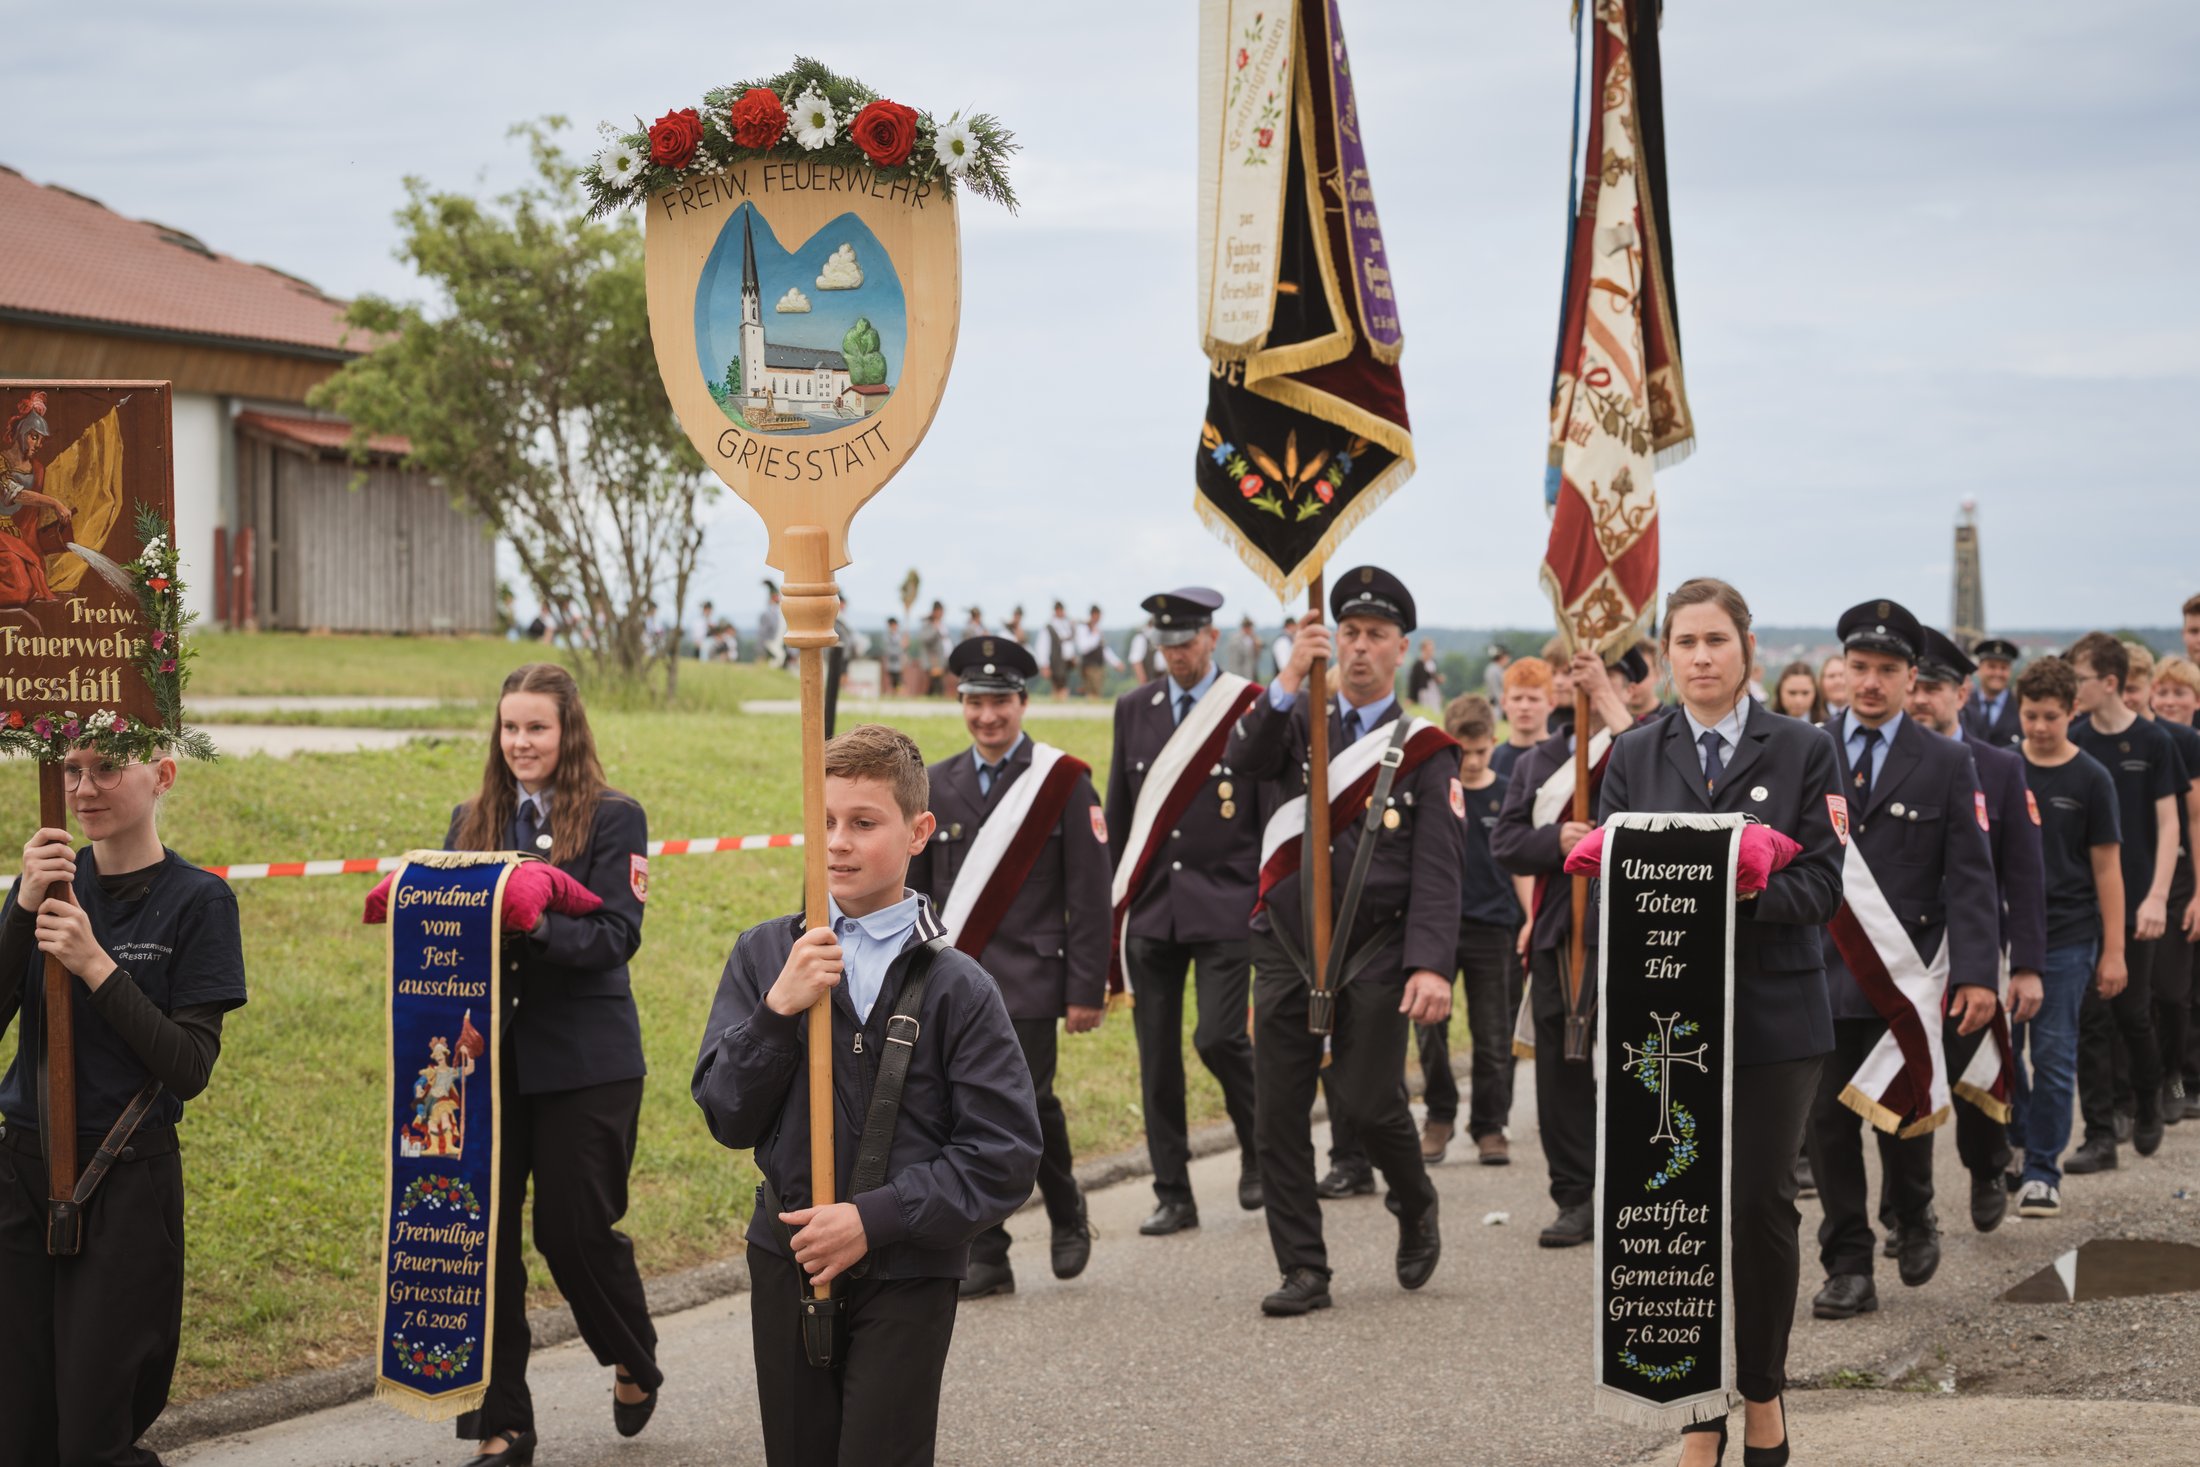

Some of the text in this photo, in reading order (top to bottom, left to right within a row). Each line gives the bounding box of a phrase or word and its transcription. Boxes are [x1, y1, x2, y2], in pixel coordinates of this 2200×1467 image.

[661, 169, 751, 221] FREIW.
[717, 421, 891, 481] GRIESSTÄTT
[65, 597, 139, 624] Freiw.
[1621, 858, 1714, 881] Unseren
[398, 884, 489, 909] Gewidmet
[1635, 890, 1697, 914] Toten
[421, 919, 462, 937] vom
[1645, 929, 1686, 946] zur
[420, 946, 464, 970] Fest-
[1645, 955, 1687, 979] Ehr
[398, 975, 487, 997] ausschuss
[1616, 1199, 1710, 1230] gestiftet
[391, 1221, 485, 1252] Freiwillige
[1619, 1232, 1706, 1256] von der
[390, 1251, 484, 1276] Feuerwehr
[1610, 1264, 1715, 1290] Gemeinde
[390, 1280, 482, 1306] Griesstätt
[402, 1309, 468, 1330] 7.6.2026
[1609, 1296, 1716, 1321] Griesstätt
[1625, 1325, 1701, 1347] 7.6.2026
